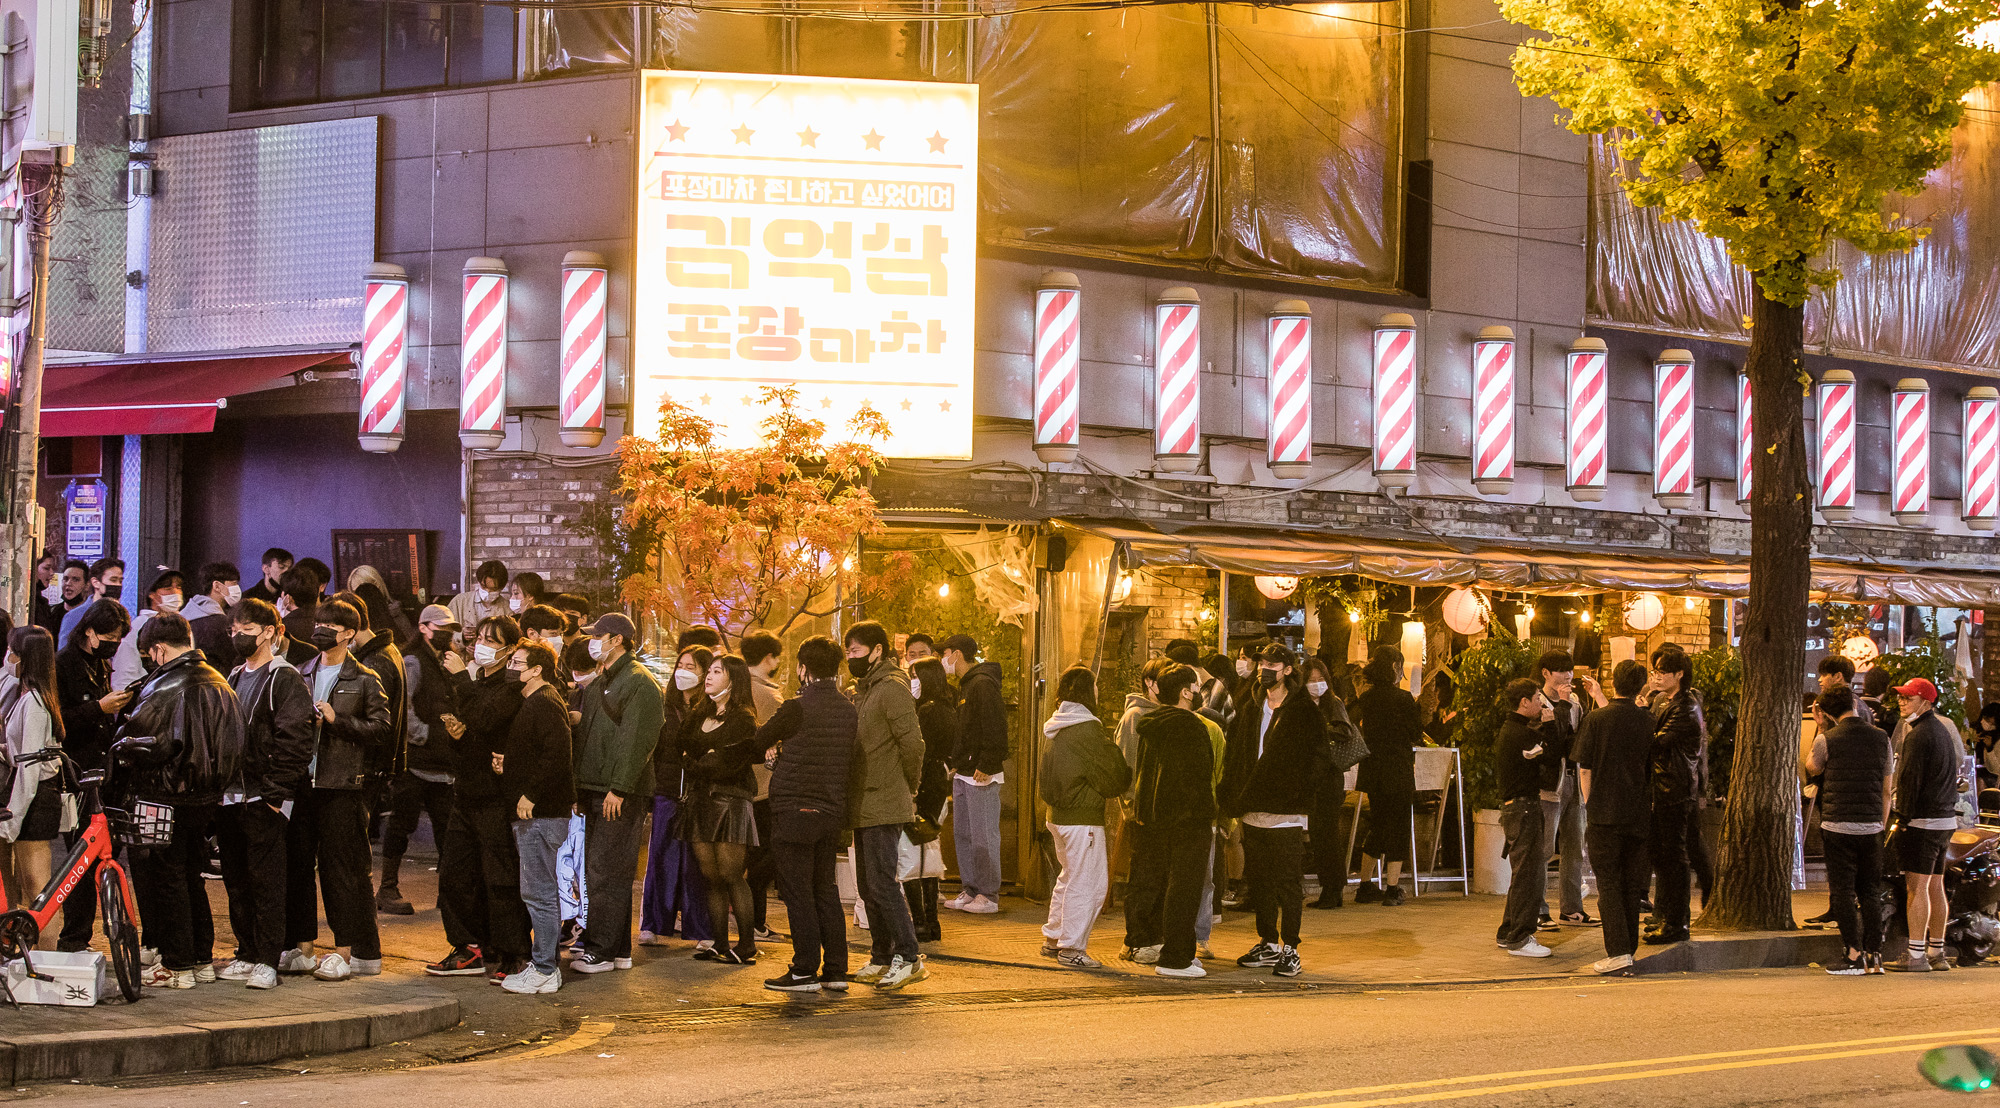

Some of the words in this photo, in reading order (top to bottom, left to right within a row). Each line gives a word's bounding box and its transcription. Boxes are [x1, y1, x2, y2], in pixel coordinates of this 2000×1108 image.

[665, 173, 757, 201] 포장마차
[861, 183, 953, 209] 싶었어여
[666, 213, 949, 297] 김억삼
[667, 302, 947, 363] 포장마차
[56, 865, 85, 903] elecle
